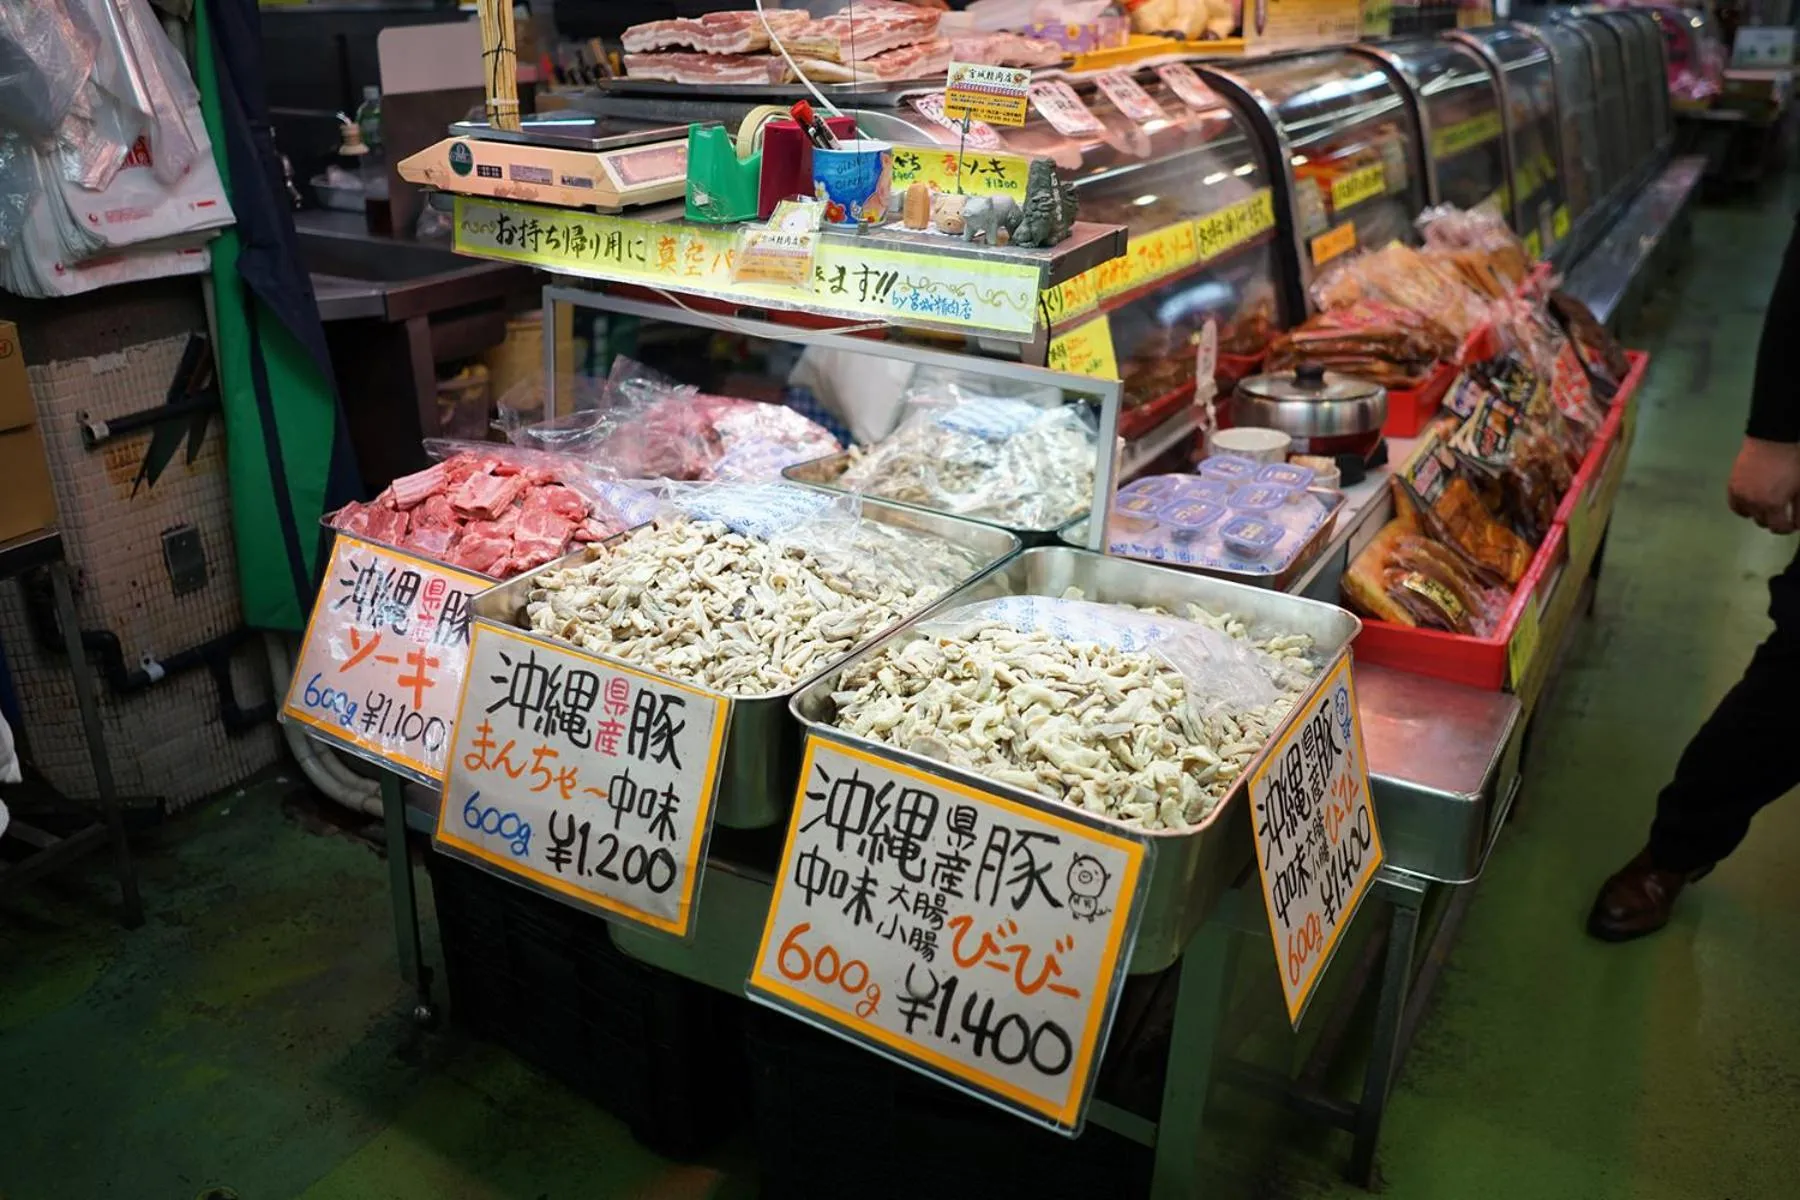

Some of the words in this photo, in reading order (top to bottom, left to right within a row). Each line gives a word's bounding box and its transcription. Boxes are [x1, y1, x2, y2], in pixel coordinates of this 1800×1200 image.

[303, 672, 359, 728] 600g
[338, 626, 441, 711] ソーキ
[485, 649, 687, 771] 沖縄県産豚
[462, 790, 533, 858] 600g
[607, 766, 681, 842] 中味
[799, 763, 1065, 912] 沖縄県産豚
[793, 843, 879, 927] 中味
[1272, 844, 1314, 928] 中味
[776, 921, 882, 1020] 600g
[1288, 912, 1324, 987] 600g
